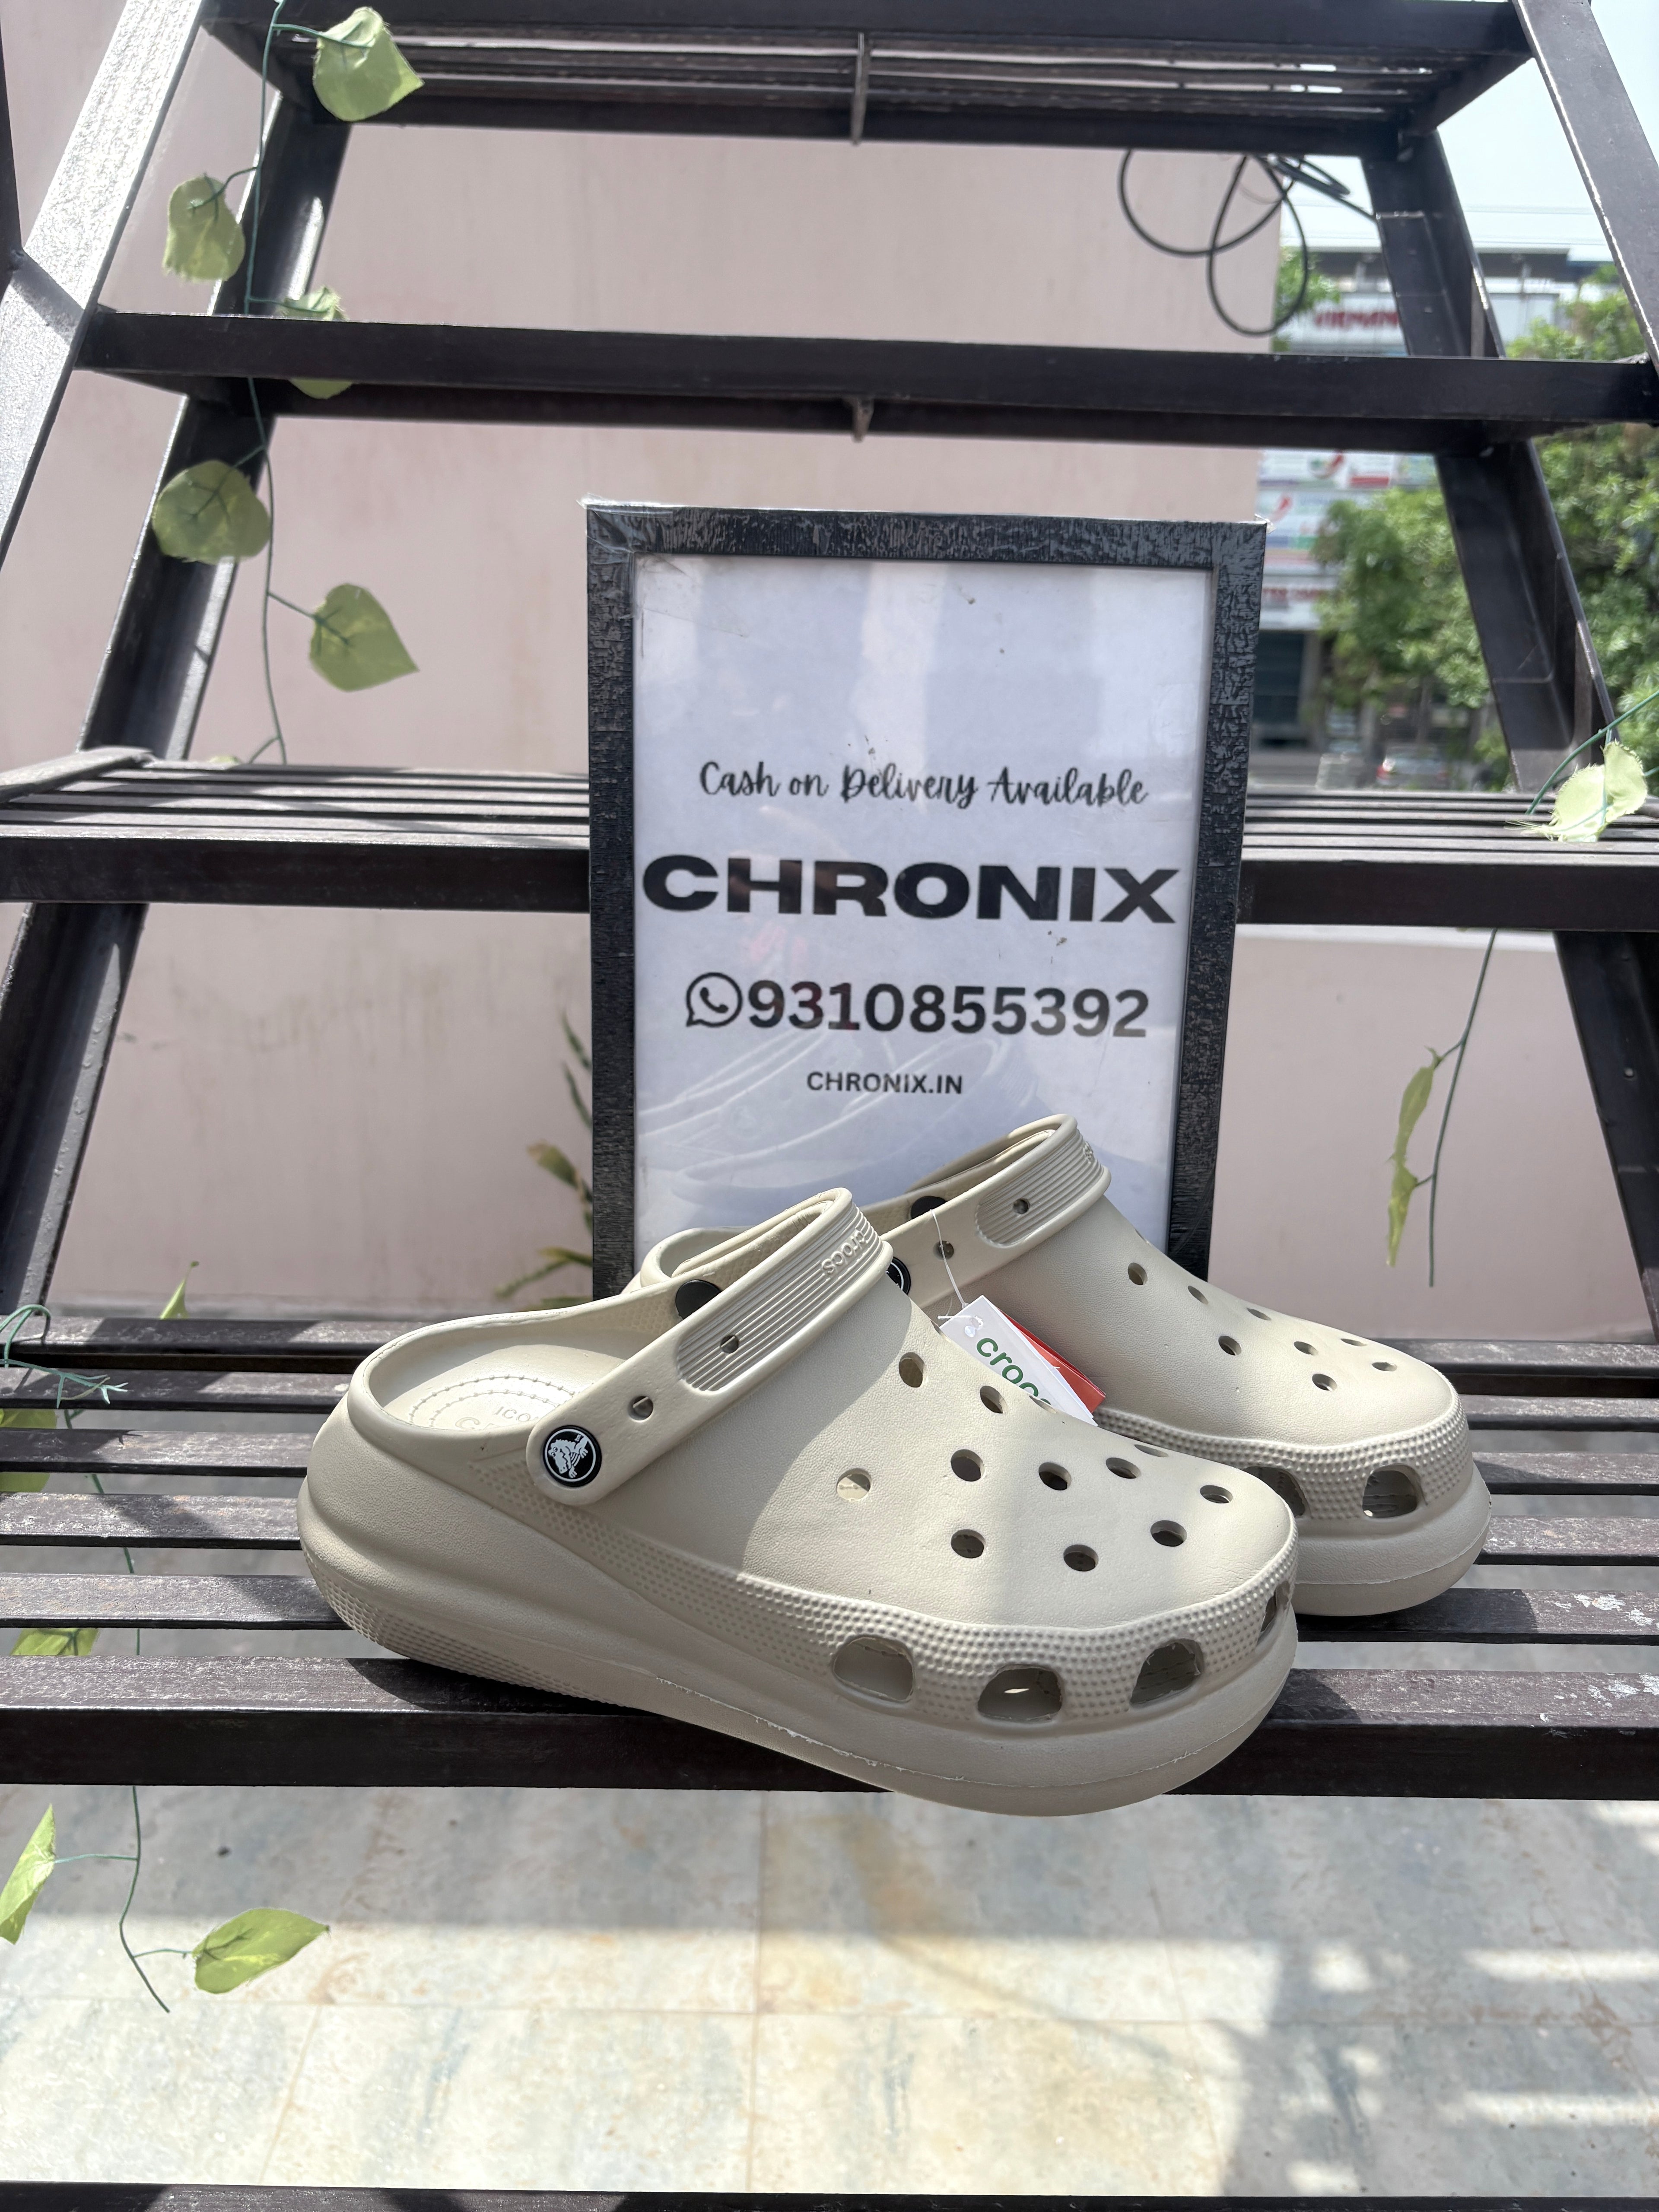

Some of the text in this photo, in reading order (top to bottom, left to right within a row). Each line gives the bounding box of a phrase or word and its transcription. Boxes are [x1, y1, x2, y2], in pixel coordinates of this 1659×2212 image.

[699, 761, 1149, 809] Cash on Delivery Available
[642, 854, 1180, 924] CHRONIX
[748, 979, 1149, 1037] 9310855392
[806, 1071, 963, 1095] CHRONIX.IN
[821, 1230, 865, 1274] crocs
